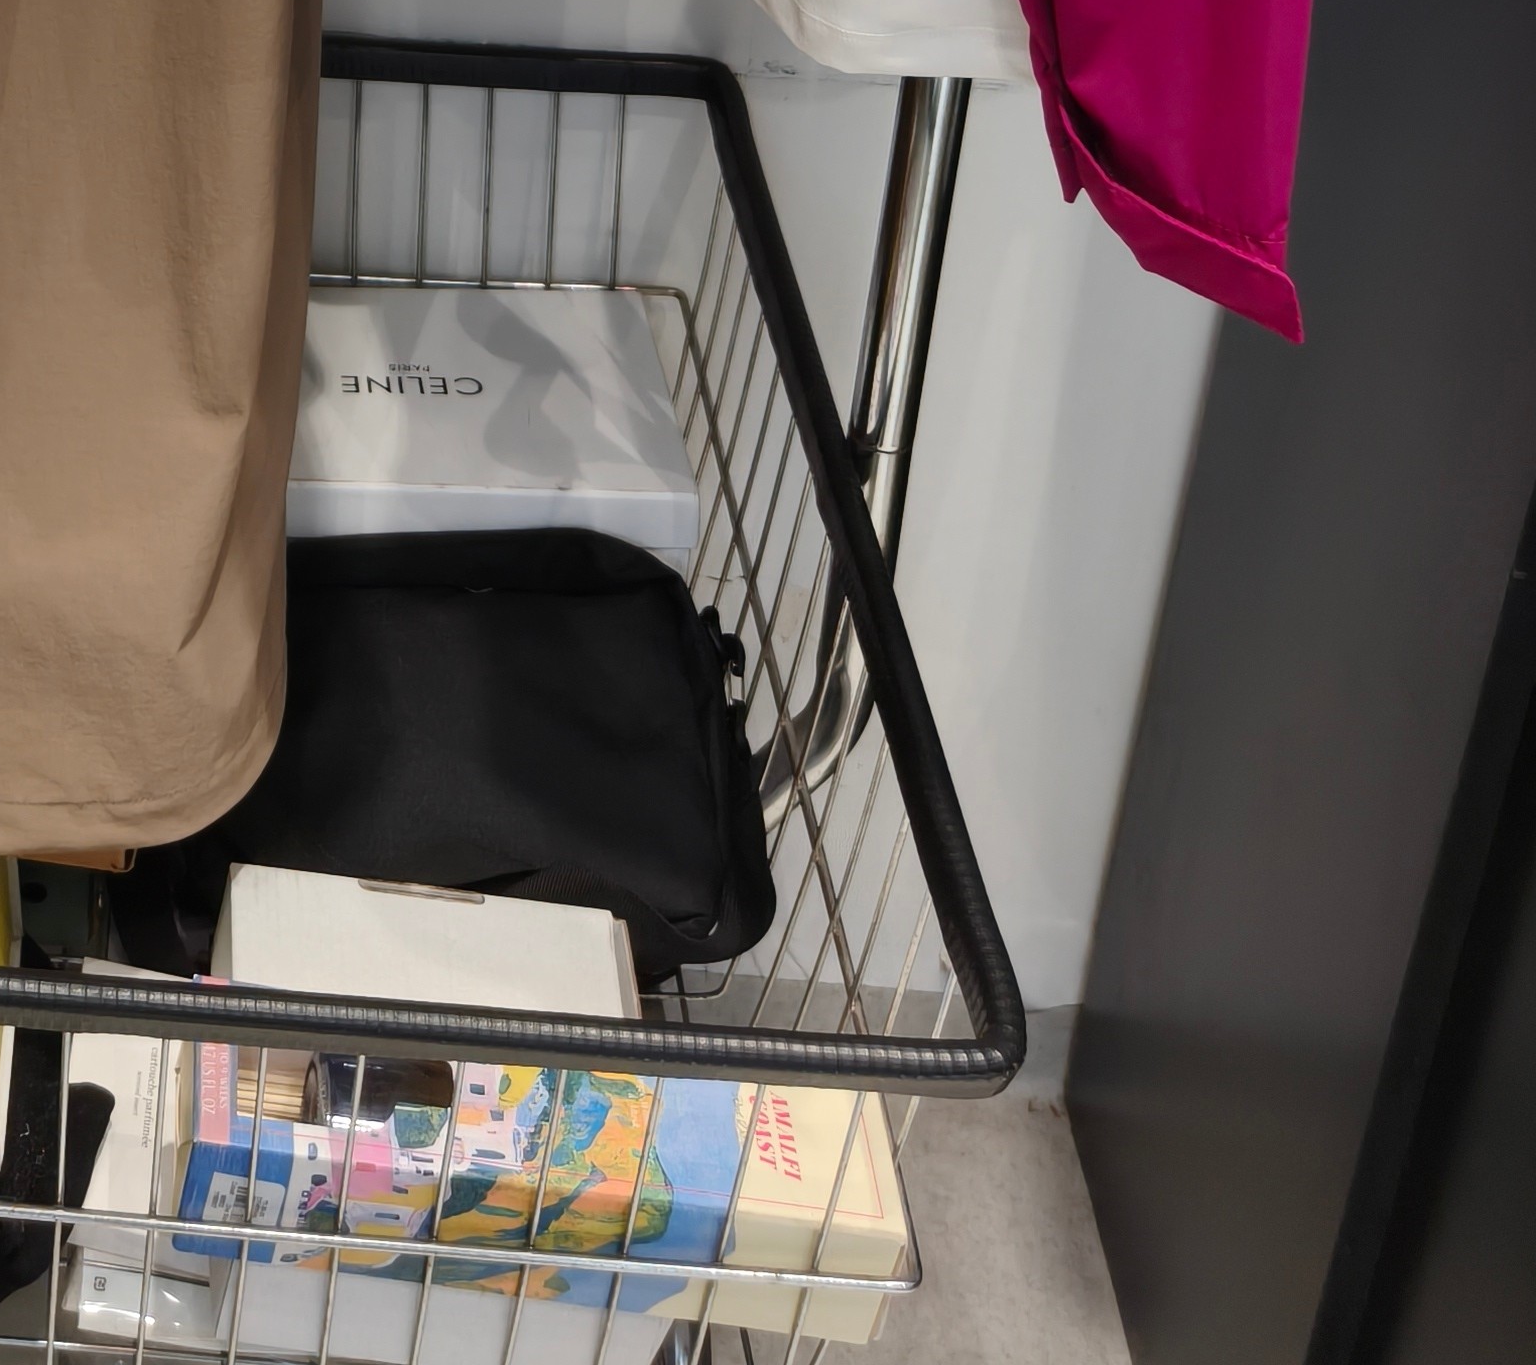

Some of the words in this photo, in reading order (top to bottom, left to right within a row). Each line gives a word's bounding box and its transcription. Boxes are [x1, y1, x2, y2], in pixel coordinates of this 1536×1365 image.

[340, 375, 484, 396] CELINE
[388, 363, 431, 373] PARIS
[147, 1046, 159, 1097] cartouche
[219, 1077, 229, 1109] WEEKS
[141, 1097, 155, 1149] parfumée
[769, 1090, 802, 1181] AMALFI
